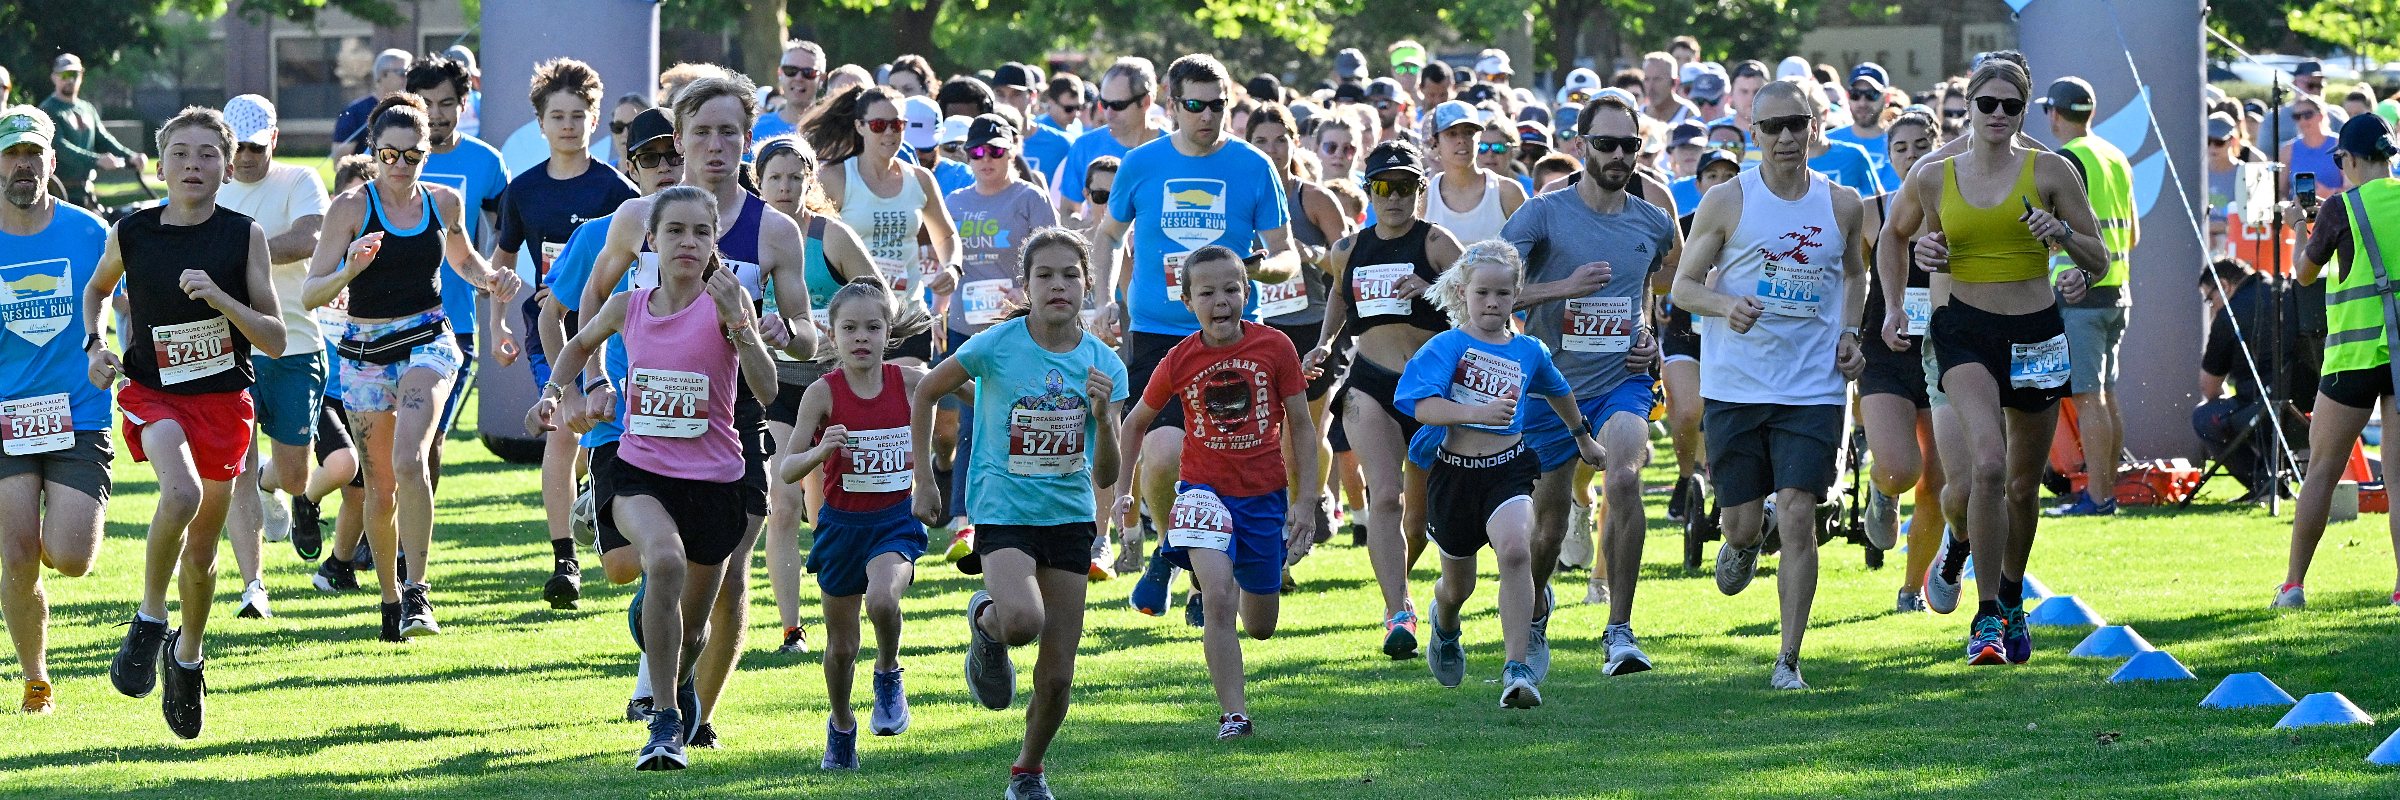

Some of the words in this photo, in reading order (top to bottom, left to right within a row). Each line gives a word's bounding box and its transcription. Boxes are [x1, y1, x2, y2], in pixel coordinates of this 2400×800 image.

[964, 211, 987, 220] THE
[1160, 217, 1200, 228] RESCUE
[1205, 218, 1226, 229] RUN
[960, 220, 999, 237] BIG
[961, 236, 993, 248] RUN
[1777, 265, 1802, 273] TREASURE
[1261, 281, 1298, 304] 5274
[1768, 278, 1814, 300] 1378
[1, 300, 39, 310] TREASURE
[2, 306, 45, 321] RESCUE
[51, 303, 73, 317] RUN
[171, 326, 200, 335] TREASURE
[202, 321, 224, 330] VALLEY
[1573, 315, 1623, 335] 5272
[189, 331, 212, 340] RESCUE
[167, 336, 222, 365] 5290
[1478, 355, 1501, 367] TREASURE
[1501, 362, 1519, 371] VALLEY
[2021, 352, 2064, 374] 1341
[1464, 366, 1511, 397] 5382
[640, 390, 696, 417] 5278
[1254, 371, 1270, 435] CAMP
[12, 412, 63, 438] 5293
[1065, 413, 1084, 421] VALLEY
[1022, 430, 1077, 454] 5279
[1204, 441, 1227, 450] OWN
[1228, 434, 1255, 442] YOUR
[852, 447, 905, 474] 5280
[1464, 449, 1515, 468] UNDER
[1174, 506, 1224, 530] 5424
